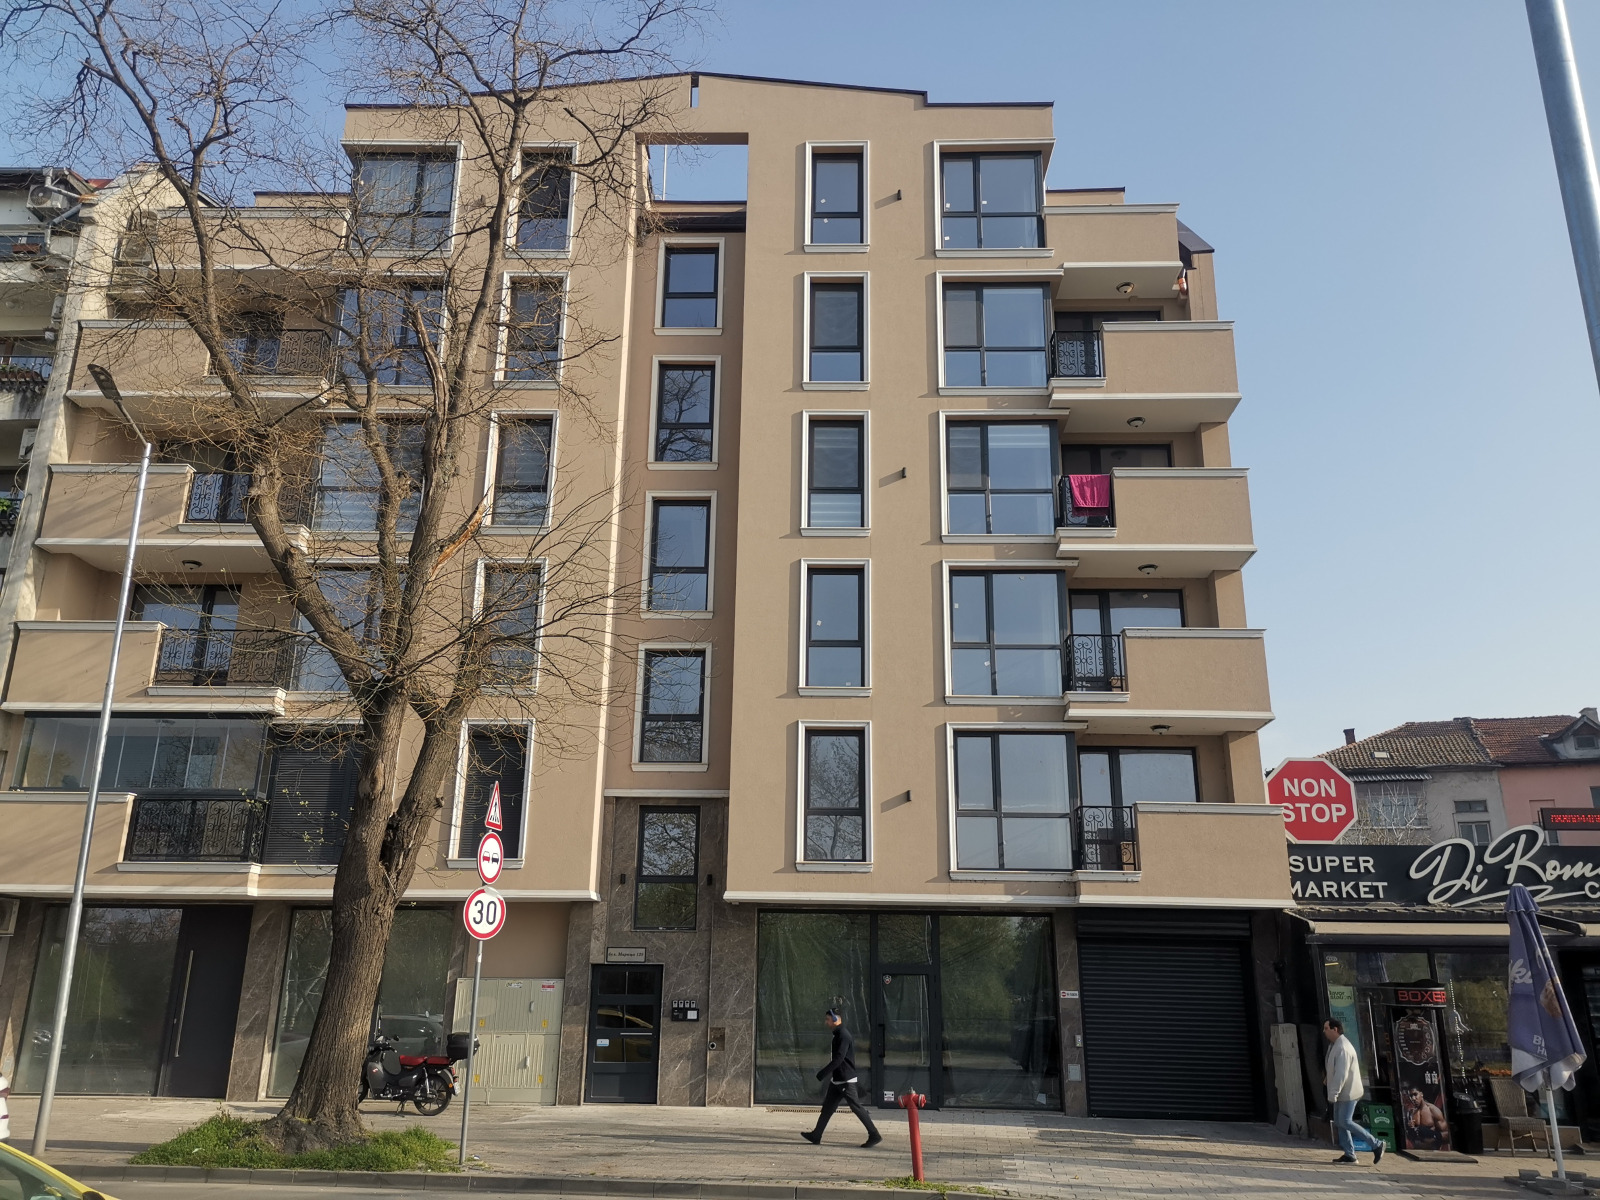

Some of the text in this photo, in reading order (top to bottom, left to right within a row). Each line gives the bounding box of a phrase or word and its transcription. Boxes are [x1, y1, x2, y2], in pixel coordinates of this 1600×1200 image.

[1283, 778, 1336, 797] NON
[1282, 803, 1346, 822] STOP
[1289, 855, 1375, 873] SUPER
[1409, 825, 1600, 904] Di Rom
[1291, 881, 1388, 899] MARKET
[473, 900, 497, 925] 30
[1398, 990, 1447, 1003] BOXER
